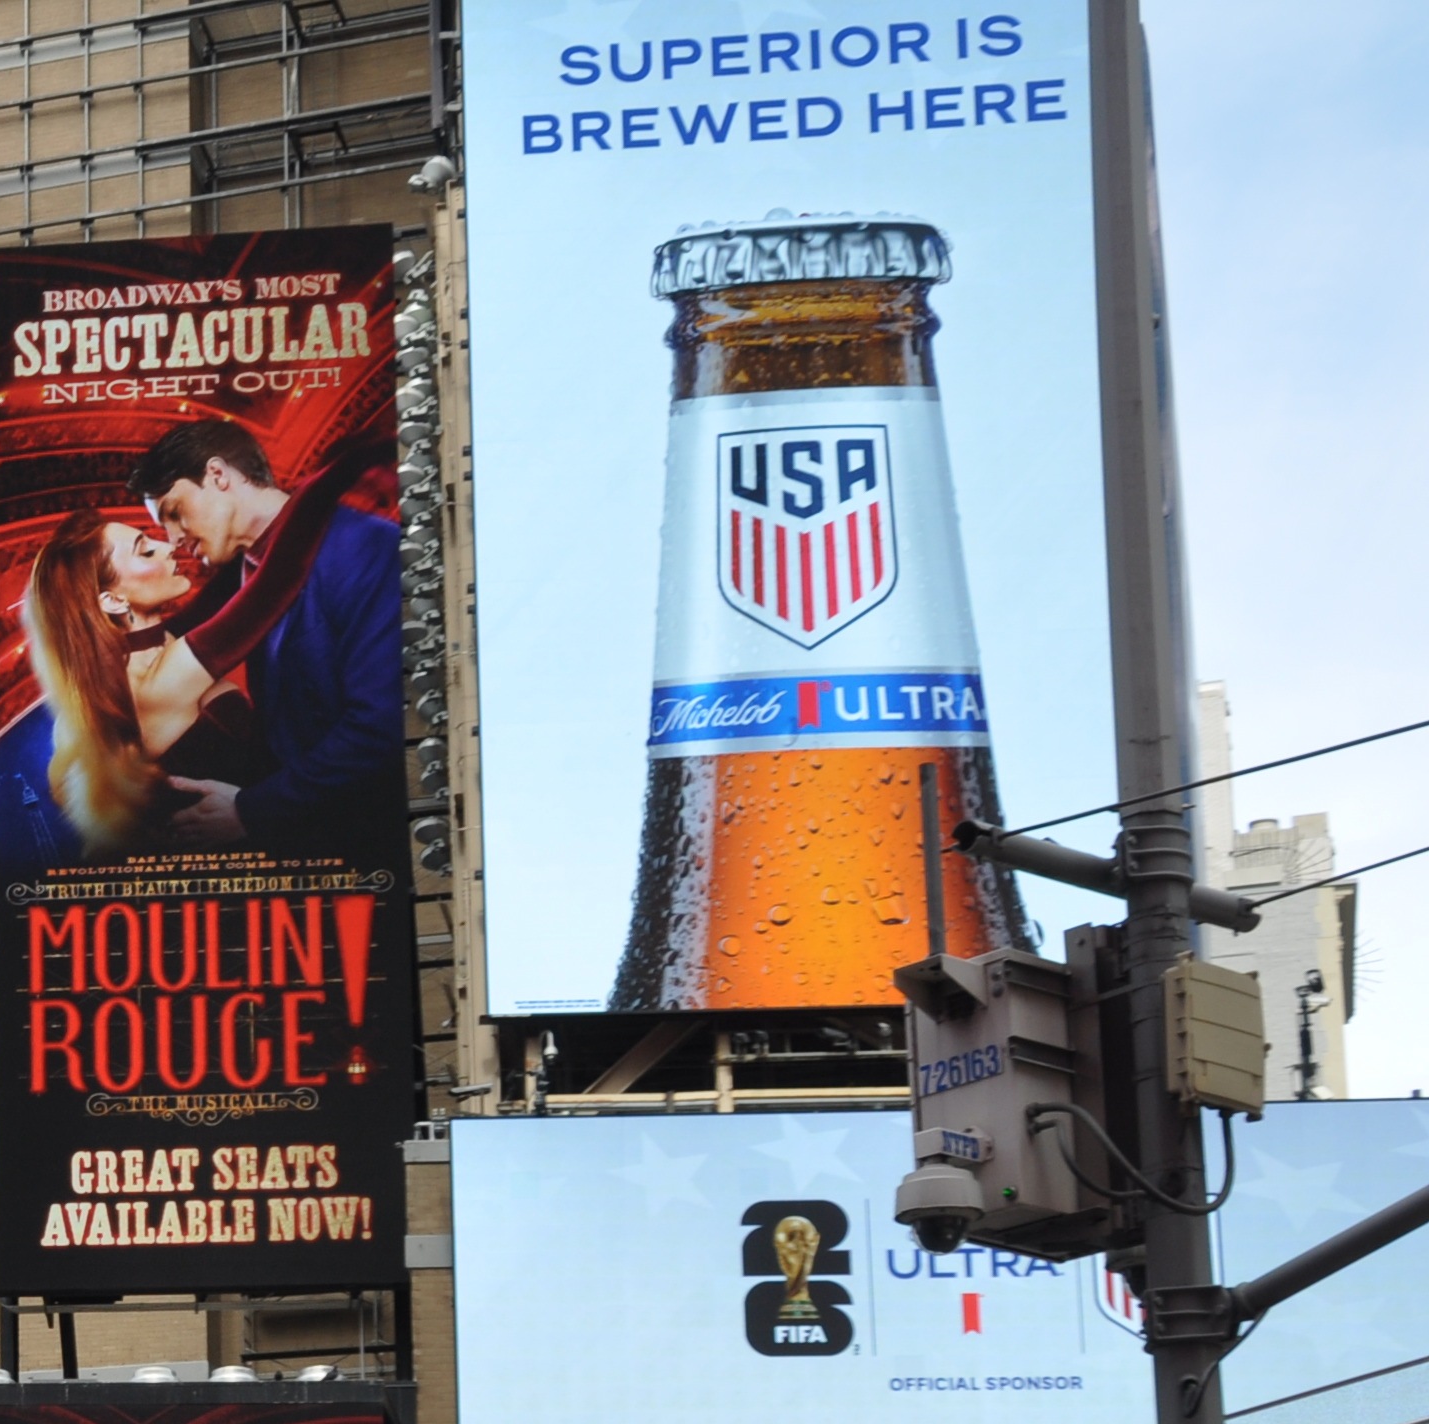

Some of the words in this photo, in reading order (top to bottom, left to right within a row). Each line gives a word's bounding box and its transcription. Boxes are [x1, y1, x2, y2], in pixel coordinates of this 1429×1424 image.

[559, 21, 931, 86] SUPERIOR
[955, 15, 1024, 59] IS
[522, 96, 843, 155] BREWED
[869, 79, 1068, 133] HERE
[42, 280, 243, 313] BROADWAY'S
[255, 273, 342, 299] MOST
[13, 302, 372, 378] SPECTACULAR
[43, 374, 221, 404] NIGHT
[232, 367, 343, 394] OUT!
[730, 438, 878, 520] USA
[652, 689, 789, 736] Michelob
[834, 685, 983, 722] ULTRA
[281, 859, 301, 868] TO
[305, 857, 344, 867] LIFE
[46, 882, 105, 899] TRUTH
[122, 878, 192, 897] BEAUTY
[207, 875, 293, 893] FREEDOM
[309, 873, 353, 890] LOVE
[28, 896, 323, 994] MOULIN
[920, 1044, 1002, 1096] 7-26163
[127, 1096, 169, 1113] THE
[941, 1130, 981, 1160] NYPD
[71, 1148, 200, 1194] GREAT
[212, 1145, 340, 1191] SEATS
[40, 1200, 256, 1247] AVAILABLE
[267, 1196, 373, 1242] NOW!
[887, 1246, 1059, 1279] ULTRA
[773, 1325, 828, 1344] FIFA
[889, 1375, 981, 1392] OFFICIAL
[986, 1375, 1084, 1391] SPONSOR
